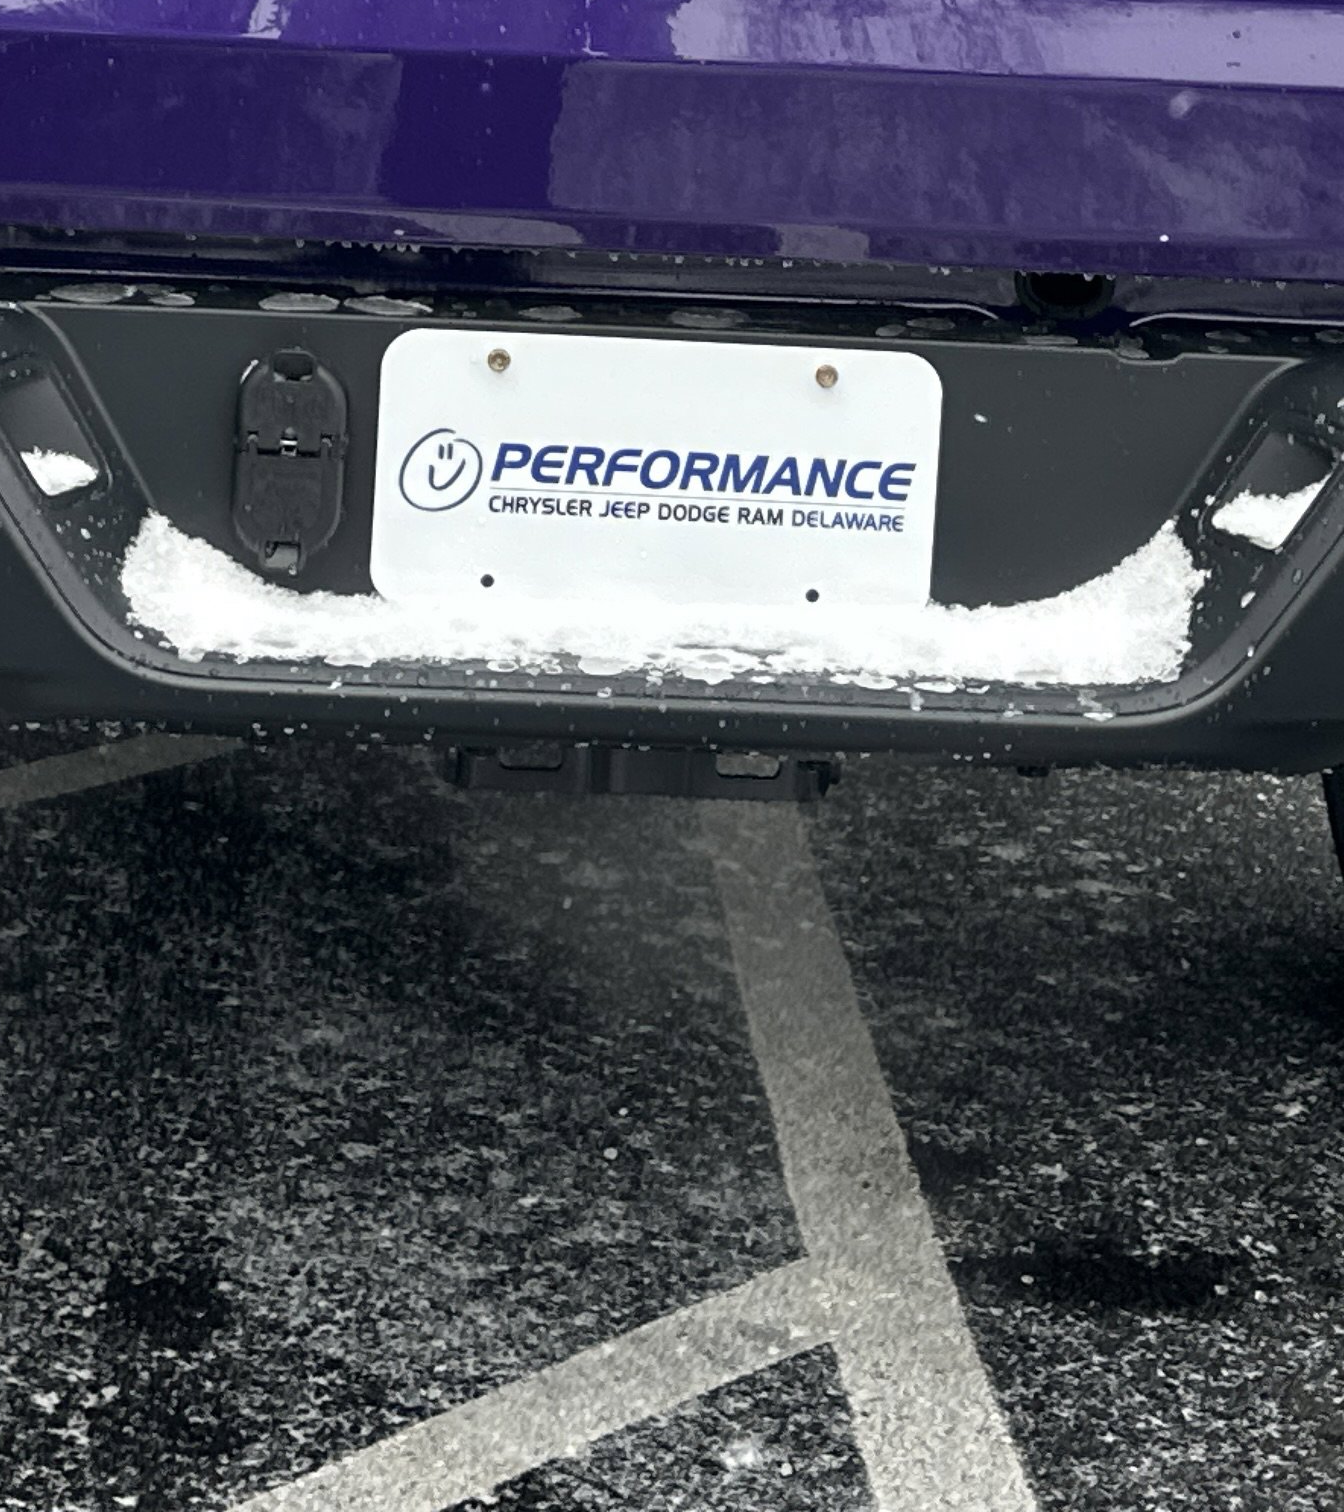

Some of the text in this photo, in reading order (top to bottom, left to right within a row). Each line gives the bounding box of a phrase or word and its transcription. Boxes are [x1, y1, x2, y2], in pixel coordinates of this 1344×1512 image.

[490, 442, 917, 501] PERFORMANCE
[488, 495, 905, 532] CHRYSLER JEEP DODGE RAM DELAWARE
